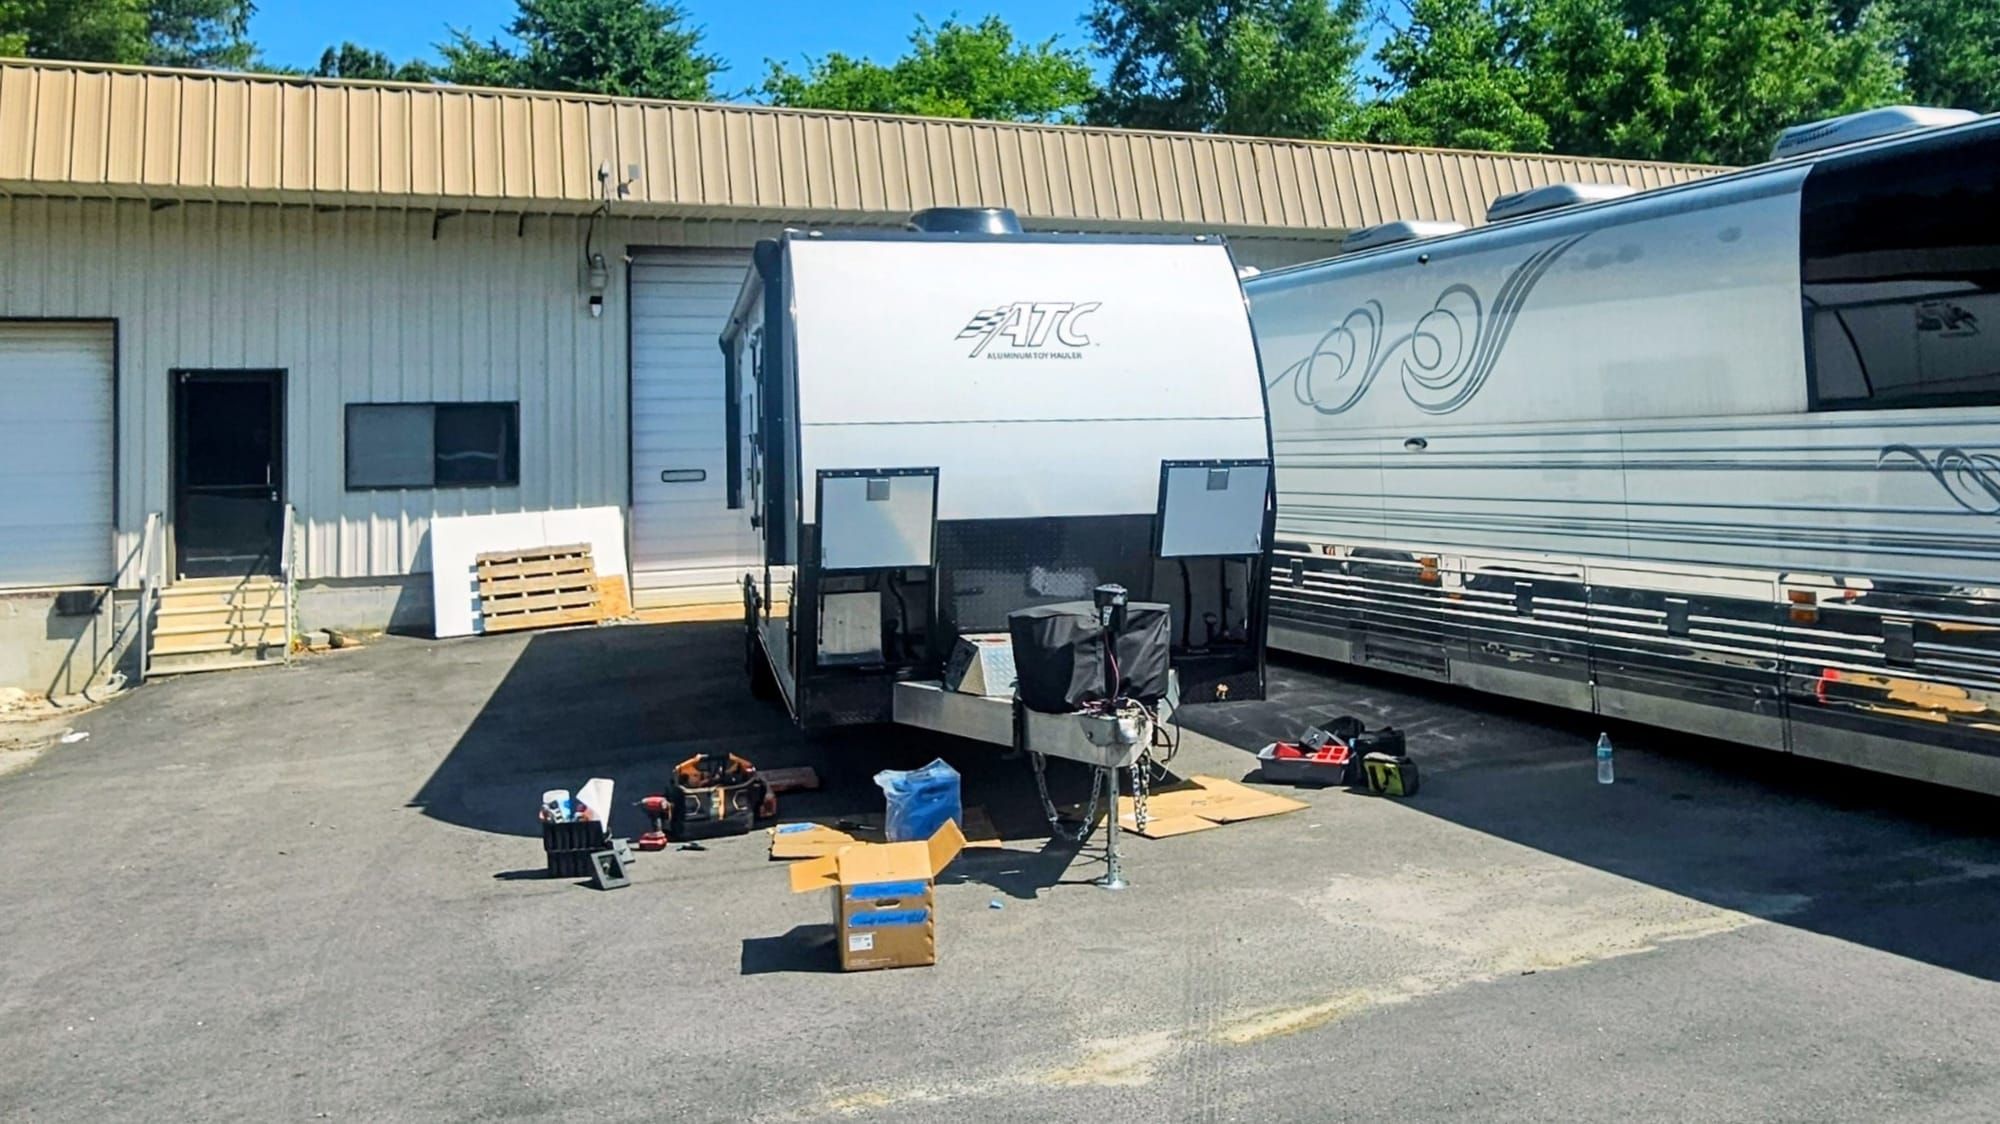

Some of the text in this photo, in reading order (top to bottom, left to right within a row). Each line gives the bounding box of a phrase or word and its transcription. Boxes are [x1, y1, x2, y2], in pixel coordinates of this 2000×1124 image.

[969, 302, 1102, 357] ATC
[987, 352, 1082, 360] ALUMINUM TOY HAULER
